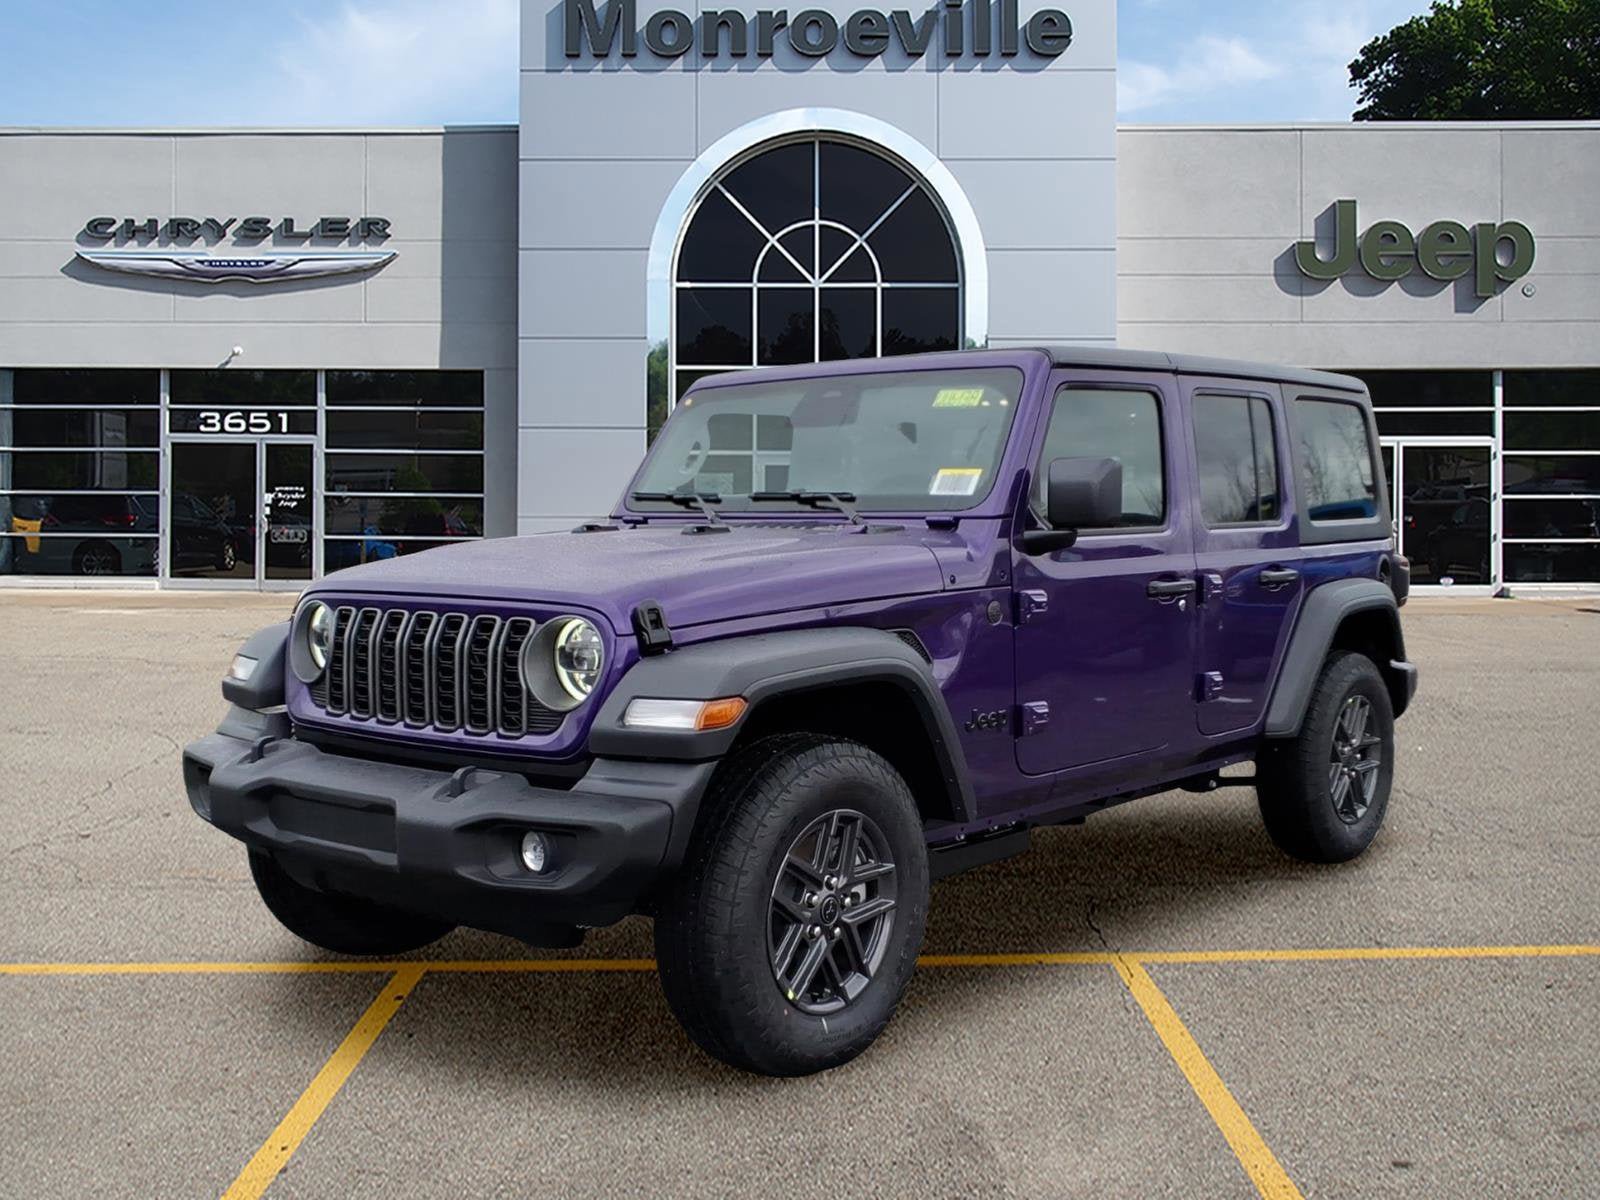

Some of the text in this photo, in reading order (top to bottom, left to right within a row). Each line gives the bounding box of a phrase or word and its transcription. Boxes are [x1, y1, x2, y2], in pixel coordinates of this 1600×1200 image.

[563, 0, 1073, 57] Monroeville
[84, 217, 391, 238] CHRYSLER
[1295, 199, 1535, 297] Jeep
[199, 412, 289, 433] 3651
[965, 707, 1007, 733] Jeep
